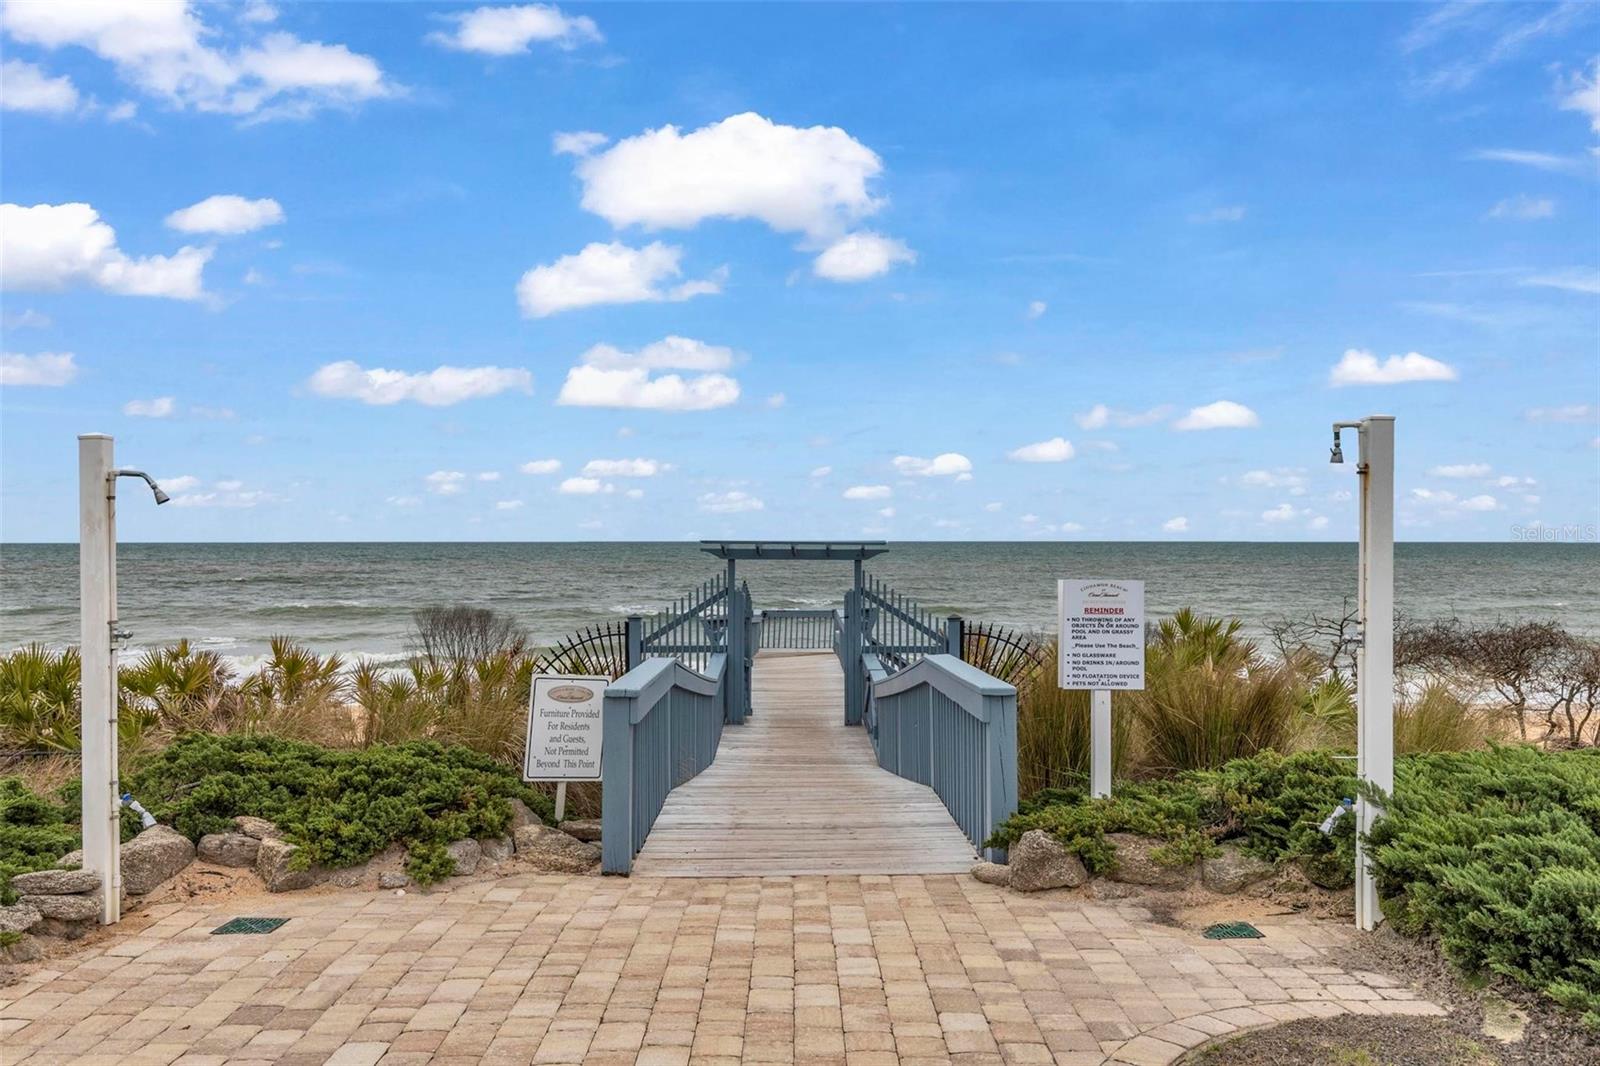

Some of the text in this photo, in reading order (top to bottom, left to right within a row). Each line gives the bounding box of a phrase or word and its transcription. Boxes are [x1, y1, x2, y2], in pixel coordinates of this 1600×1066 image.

[540, 708, 600, 718] Furniture Provided
[548, 722, 590, 730] For Residents
[549, 734, 561, 743] and
[545, 747, 589, 755] Not Permitted
[536, 760, 595, 769] Beyond This Point
